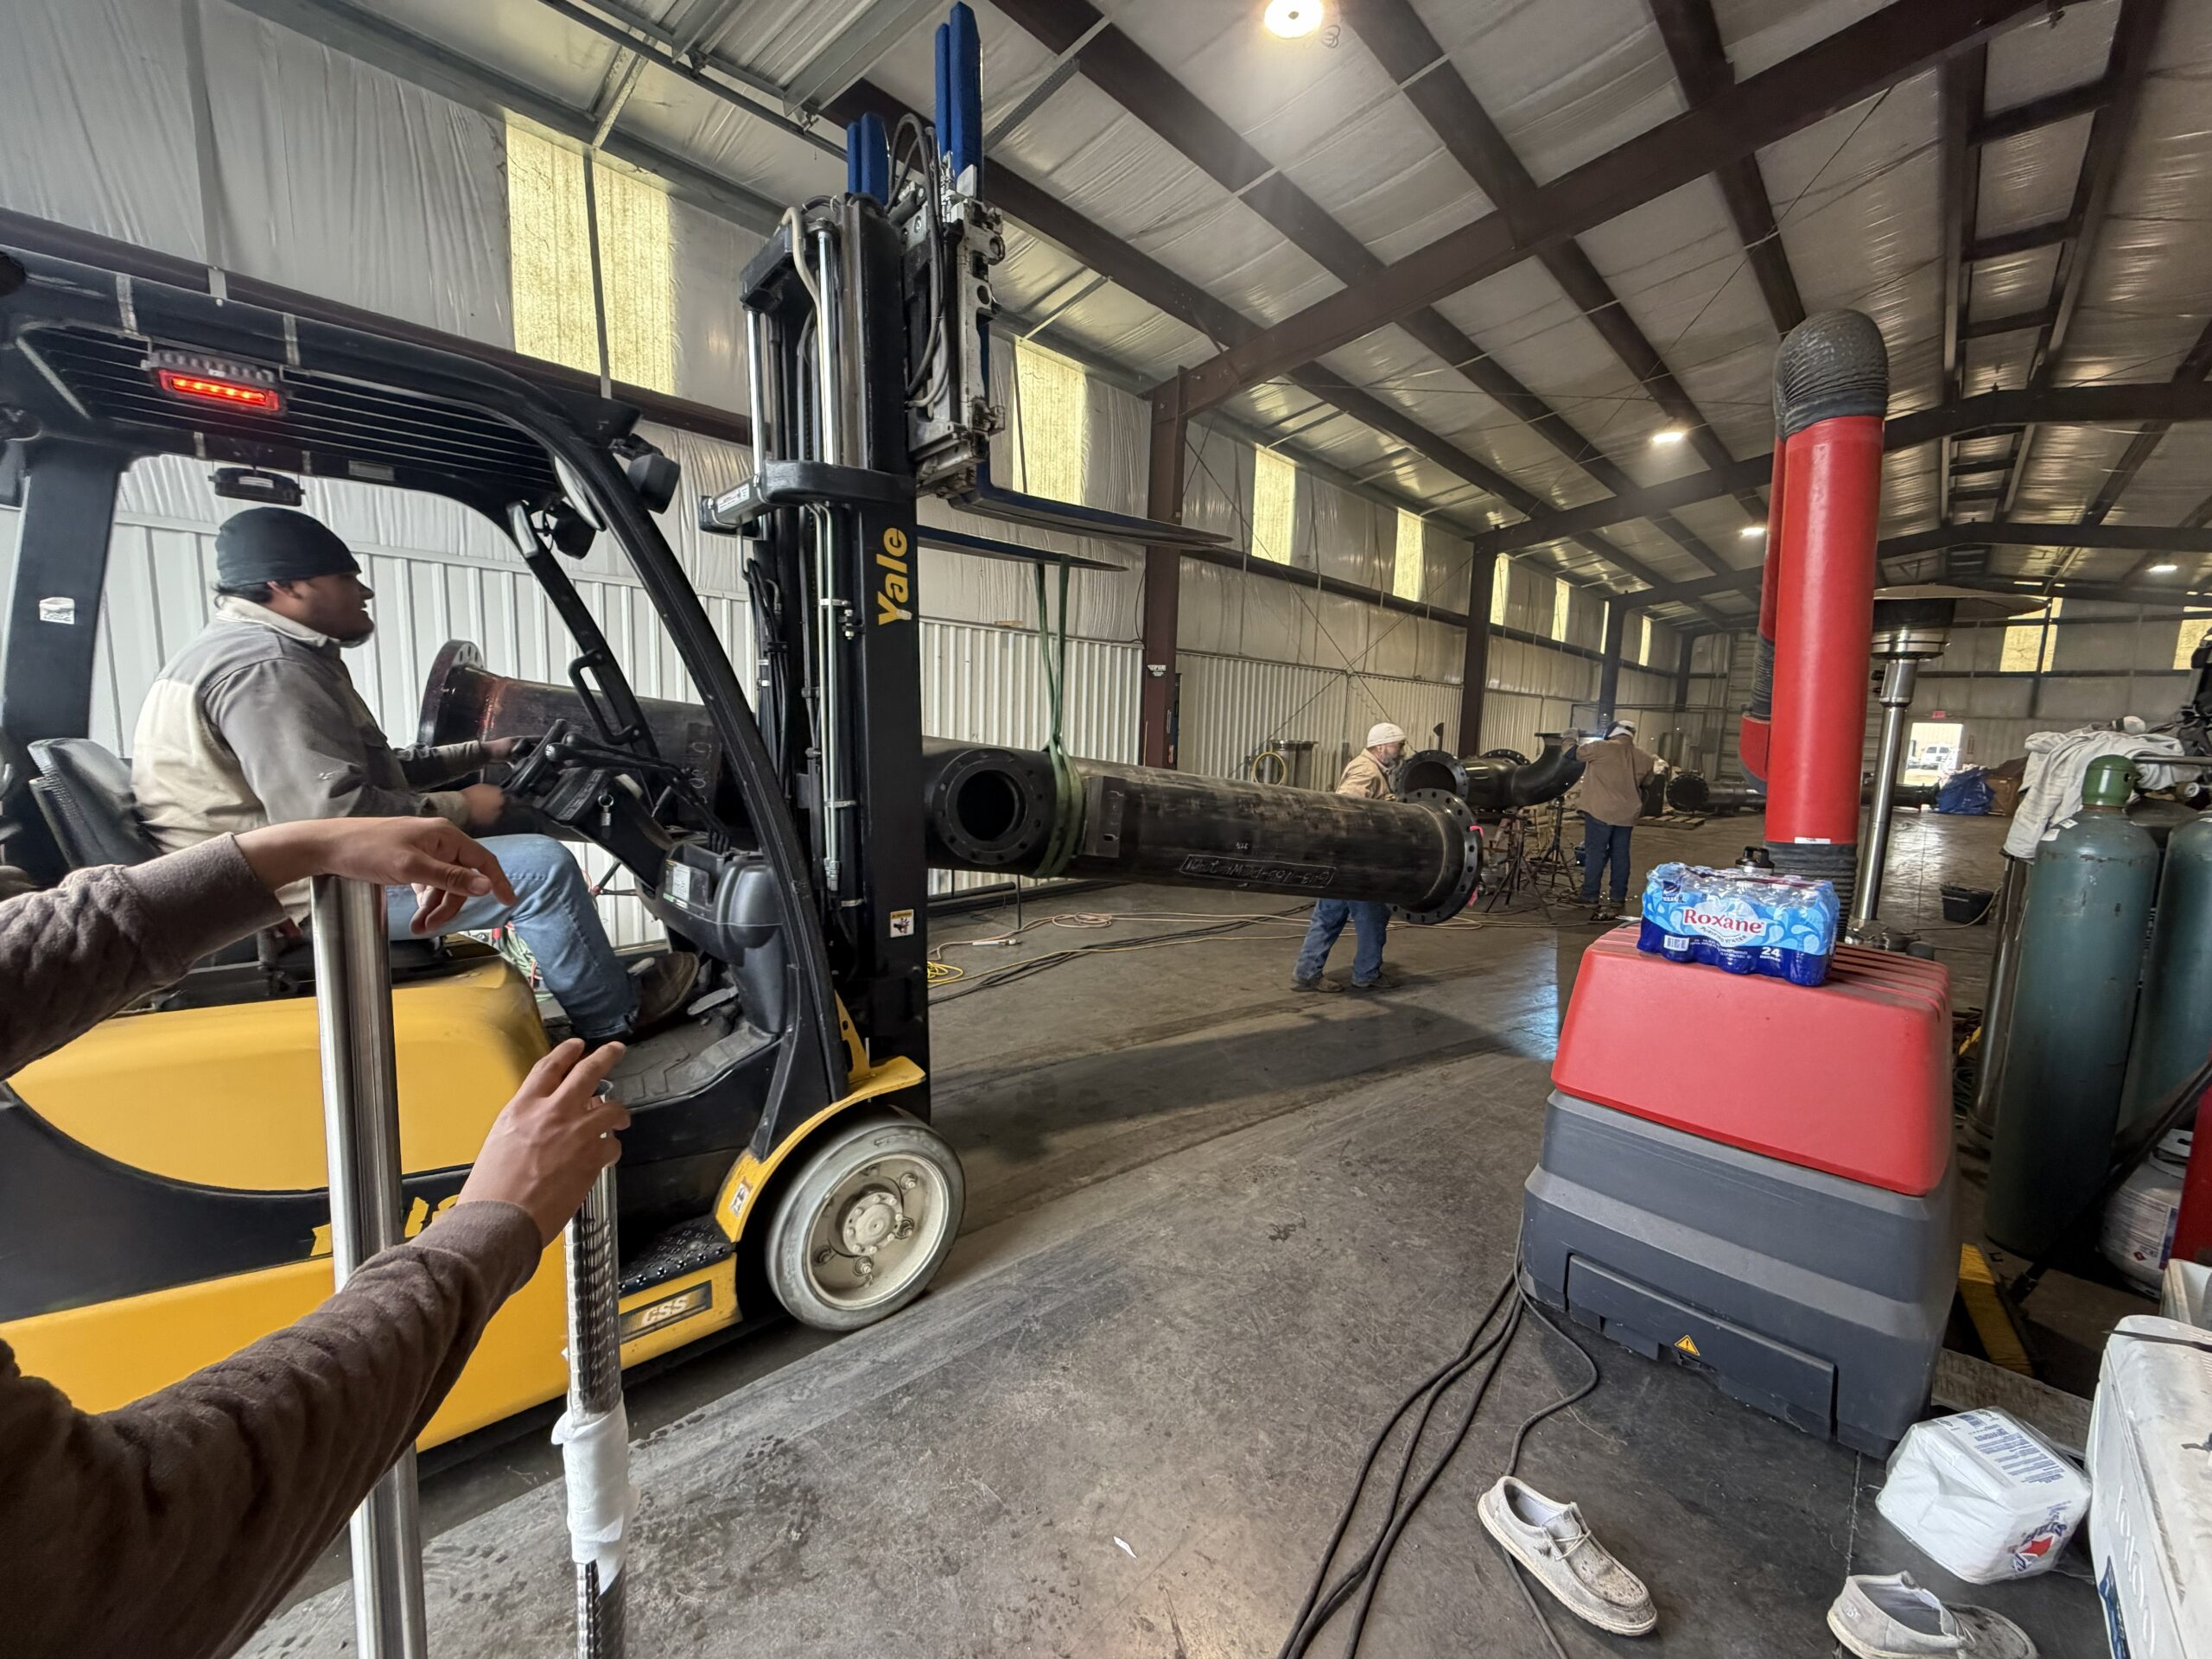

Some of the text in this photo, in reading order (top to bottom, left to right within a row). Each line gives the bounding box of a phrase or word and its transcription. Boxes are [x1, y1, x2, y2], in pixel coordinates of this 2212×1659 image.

[876, 527, 912, 626] Yale
[1684, 909, 1763, 934] Roxane
[1761, 946, 1781, 957] 24
